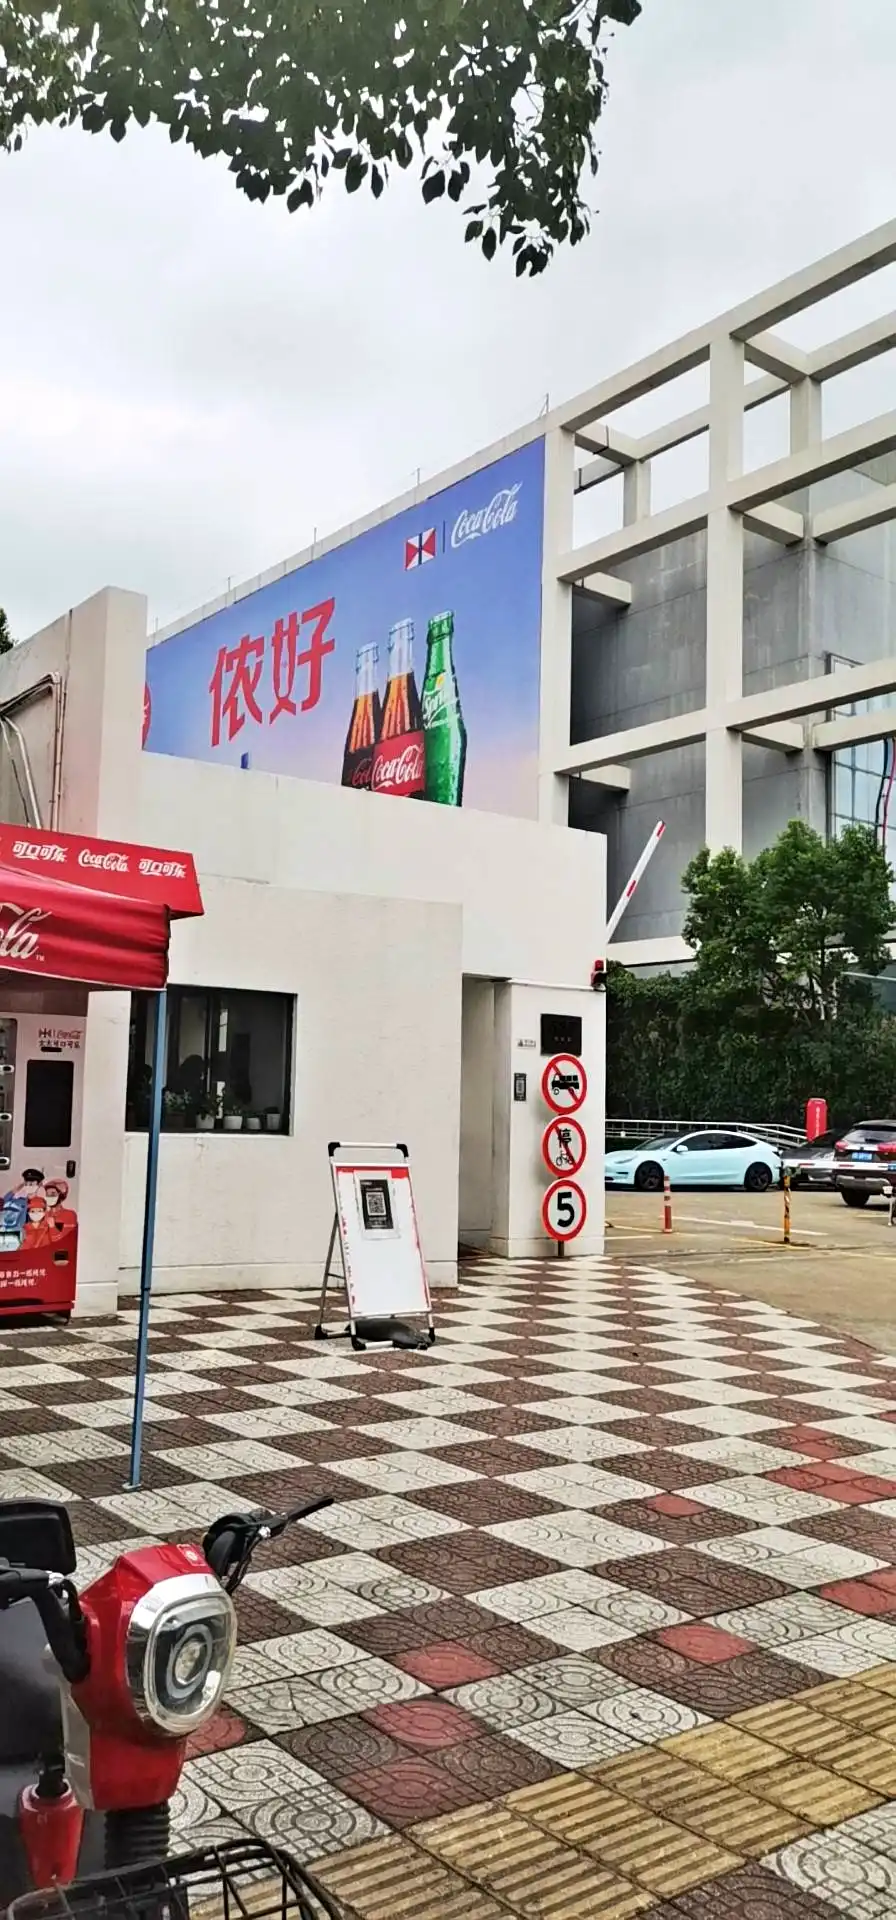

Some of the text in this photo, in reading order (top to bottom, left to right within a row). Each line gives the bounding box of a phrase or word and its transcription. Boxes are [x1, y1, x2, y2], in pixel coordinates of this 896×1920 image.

[209, 597, 335, 748] 侬好
[13, 841, 68, 862] 可口可乐
[138, 858, 187, 878] 可口可乐
[557, 1191, 575, 1228] 5
